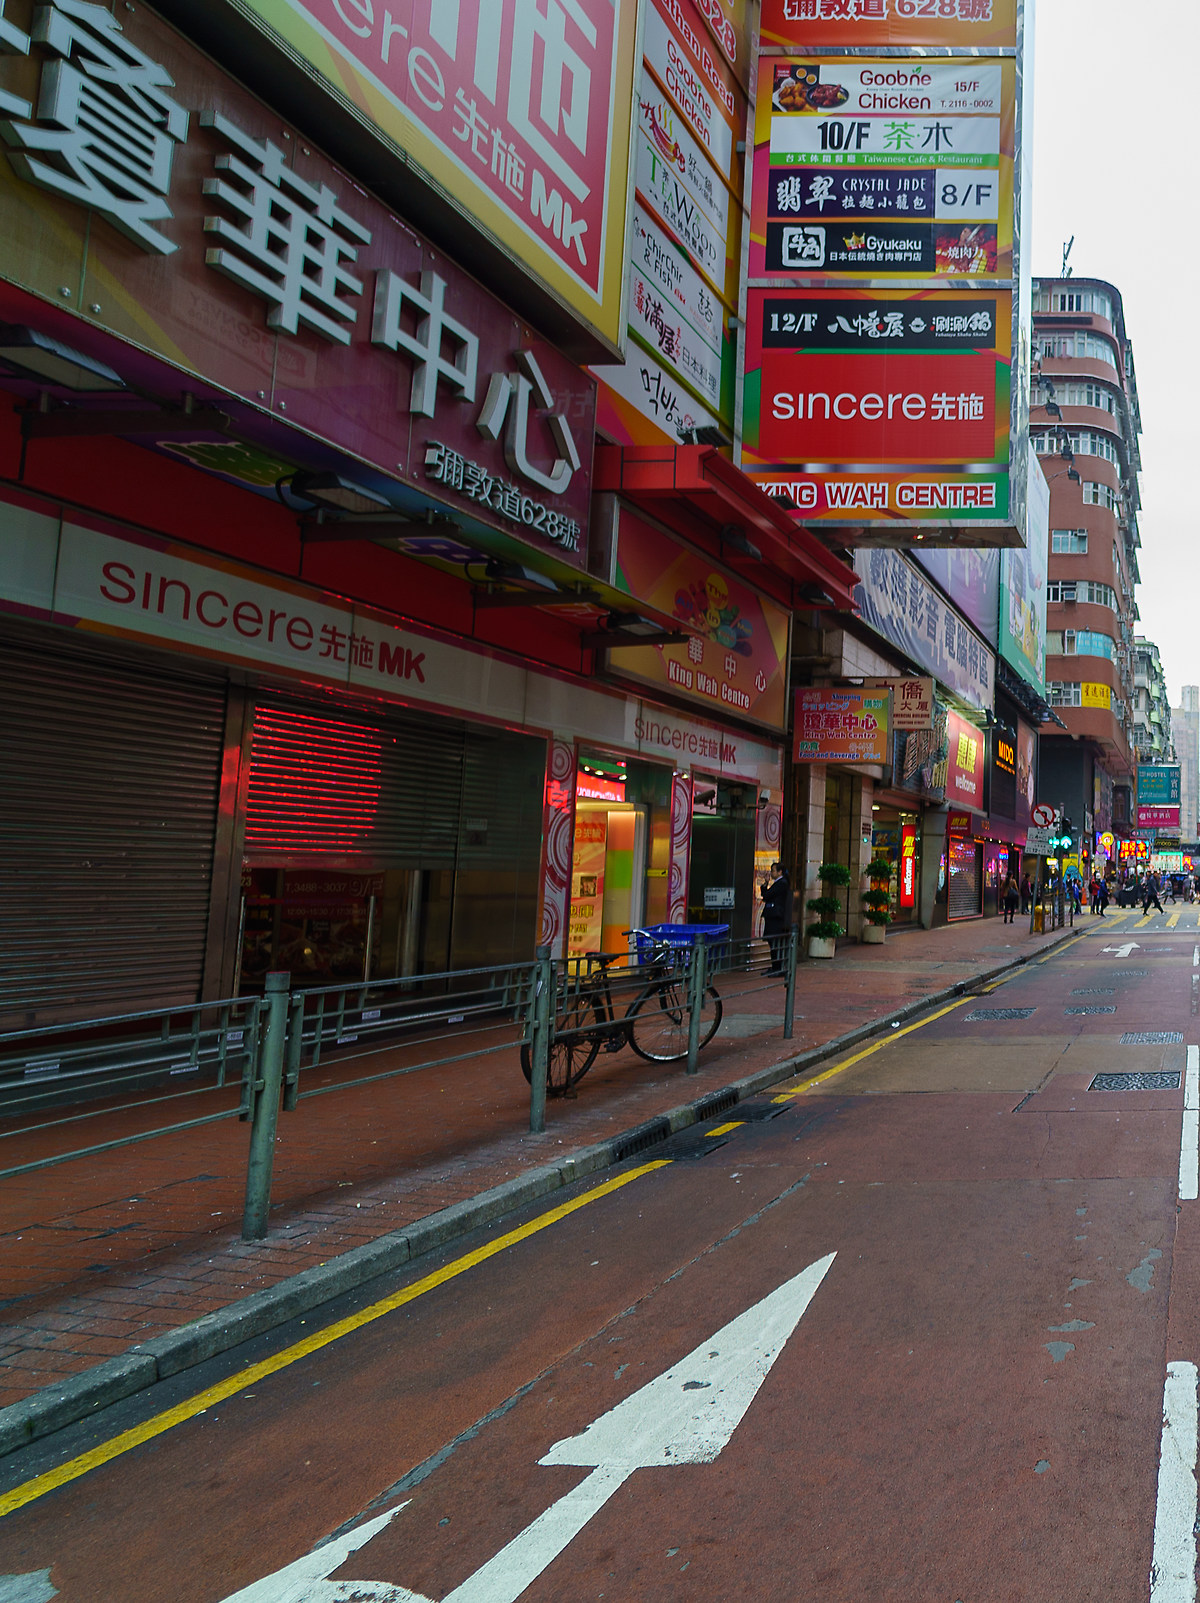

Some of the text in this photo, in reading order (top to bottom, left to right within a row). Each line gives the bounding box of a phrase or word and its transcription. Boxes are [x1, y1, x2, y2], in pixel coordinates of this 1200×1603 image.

[667, 40, 712, 119] Goobne
[702, 47, 735, 116] Road
[860, 69, 932, 86] Goobne
[954, 81, 980, 92] 15/F
[666, 66, 711, 147] Chicken
[858, 93, 931, 110] Chicken
[817, 121, 871, 150] 10/F
[863, 154, 906, 164] Taiwanese
[908, 155, 928, 164] Cafe
[929, 156, 936, 164] &
[938, 154, 983, 164] Restaurant
[452, 87, 526, 202] 先施
[530, 169, 588, 266] MK
[842, 178, 927, 192] CRYSTAL JADE
[776, 175, 837, 212] 翡翠
[941, 184, 992, 206] 8/F
[647, 233, 683, 283] ChirChir
[788, 231, 821, 259] 牛角
[866, 236, 922, 252] Gyukaku
[654, 260, 673, 290] Fish
[770, 313, 818, 334] 12/F
[682, 346, 717, 394] 日本料理
[772, 392, 984, 420] sincere 先施
[426, 440, 581, 552] 彌敦道628號
[825, 482, 889, 509] WAH
[896, 482, 996, 509] CENTRE
[100, 561, 425, 684] sincere 先施 MK
[669, 660, 750, 709] King Wah Centre
[832, 693, 861, 701] Shopping
[803, 702, 849, 711] ショッピング
[635, 717, 737, 765] sincere 先施 MK
[830, 752, 860, 760] Beverage
[955, 773, 977, 795] wellcome
[904, 857, 913, 896] wellcome
